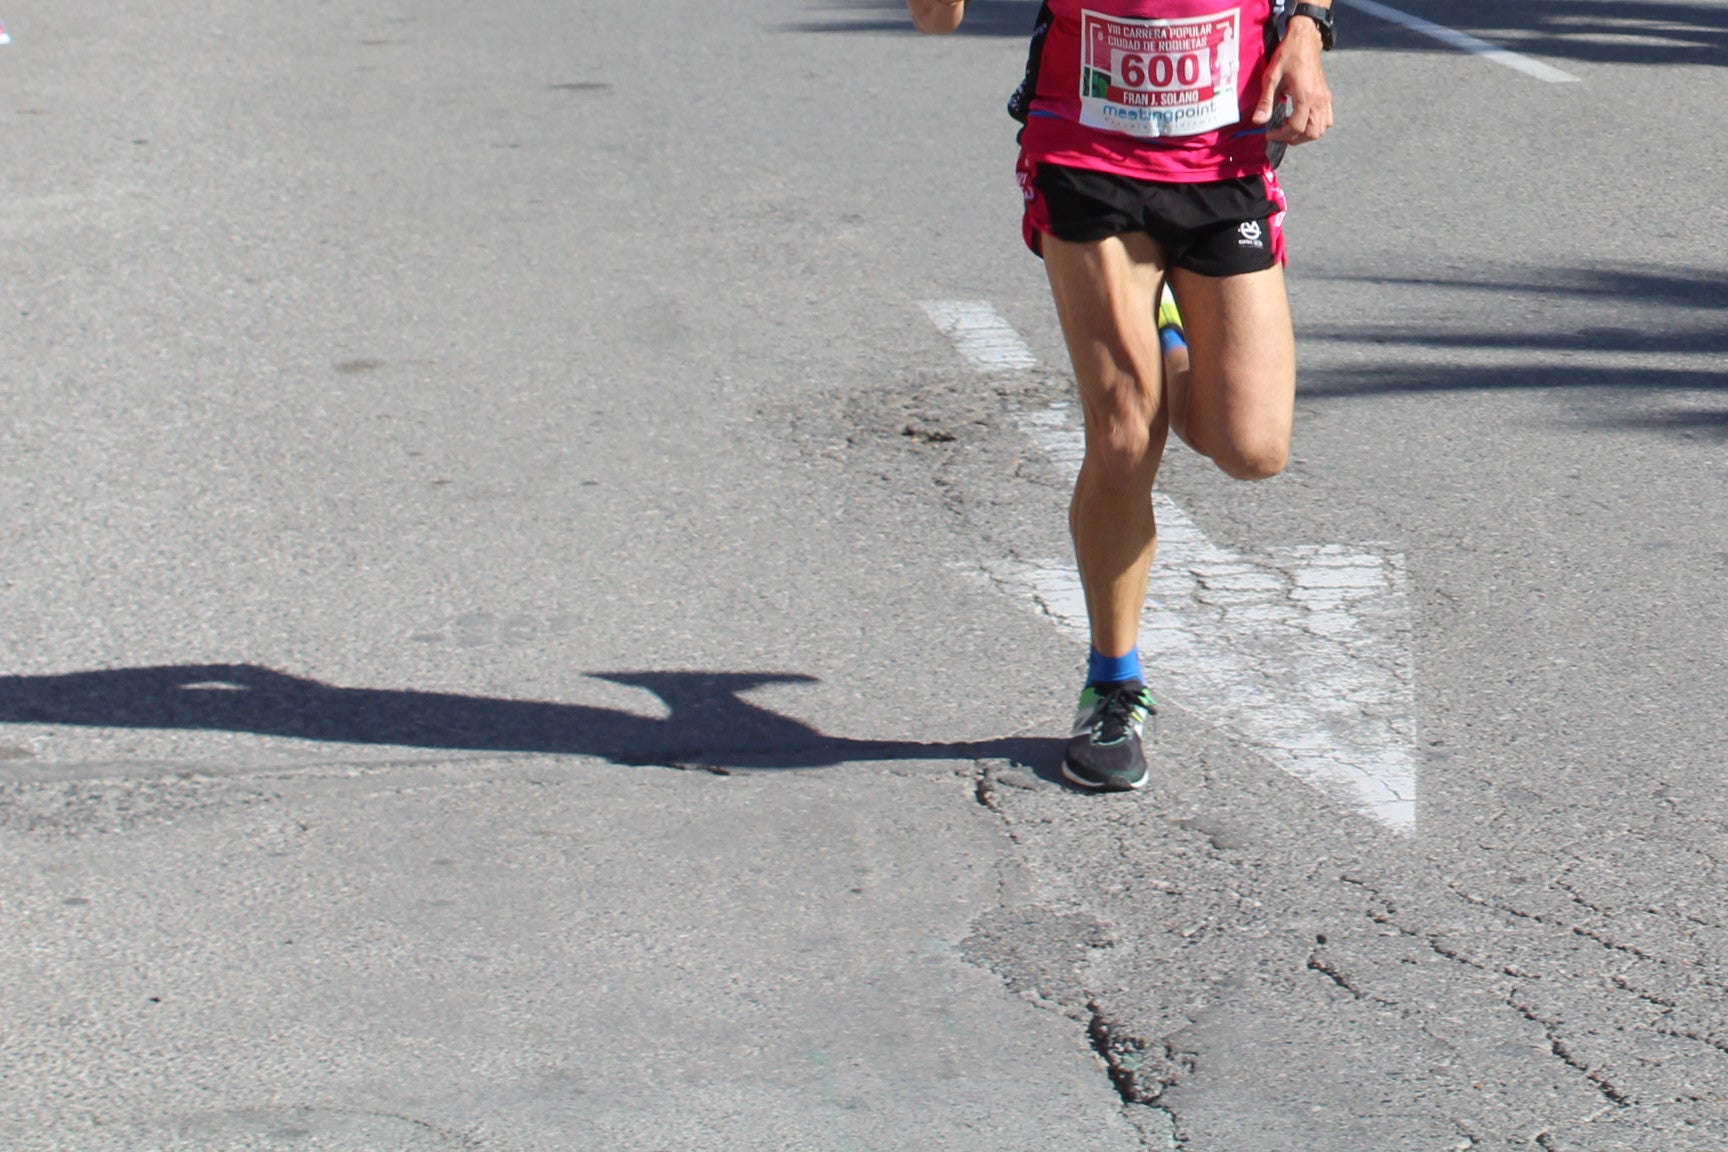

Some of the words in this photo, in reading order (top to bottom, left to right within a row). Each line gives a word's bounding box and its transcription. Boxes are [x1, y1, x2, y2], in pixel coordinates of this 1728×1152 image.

[1107, 23, 1120, 35] VIII
[1124, 27, 1167, 39] CARRERA
[1170, 23, 1212, 38] POPULAR
[1108, 36, 1141, 50] CIUDAD
[1143, 41, 1156, 51] DE
[1158, 37, 1207, 51] ROQUETAS
[1121, 53, 1200, 88] 600
[1123, 91, 1149, 104] FRAN
[1150, 92, 1159, 106] J.
[1160, 89, 1199, 105] SOLANO
[1103, 101, 1217, 122] meetingpoint
